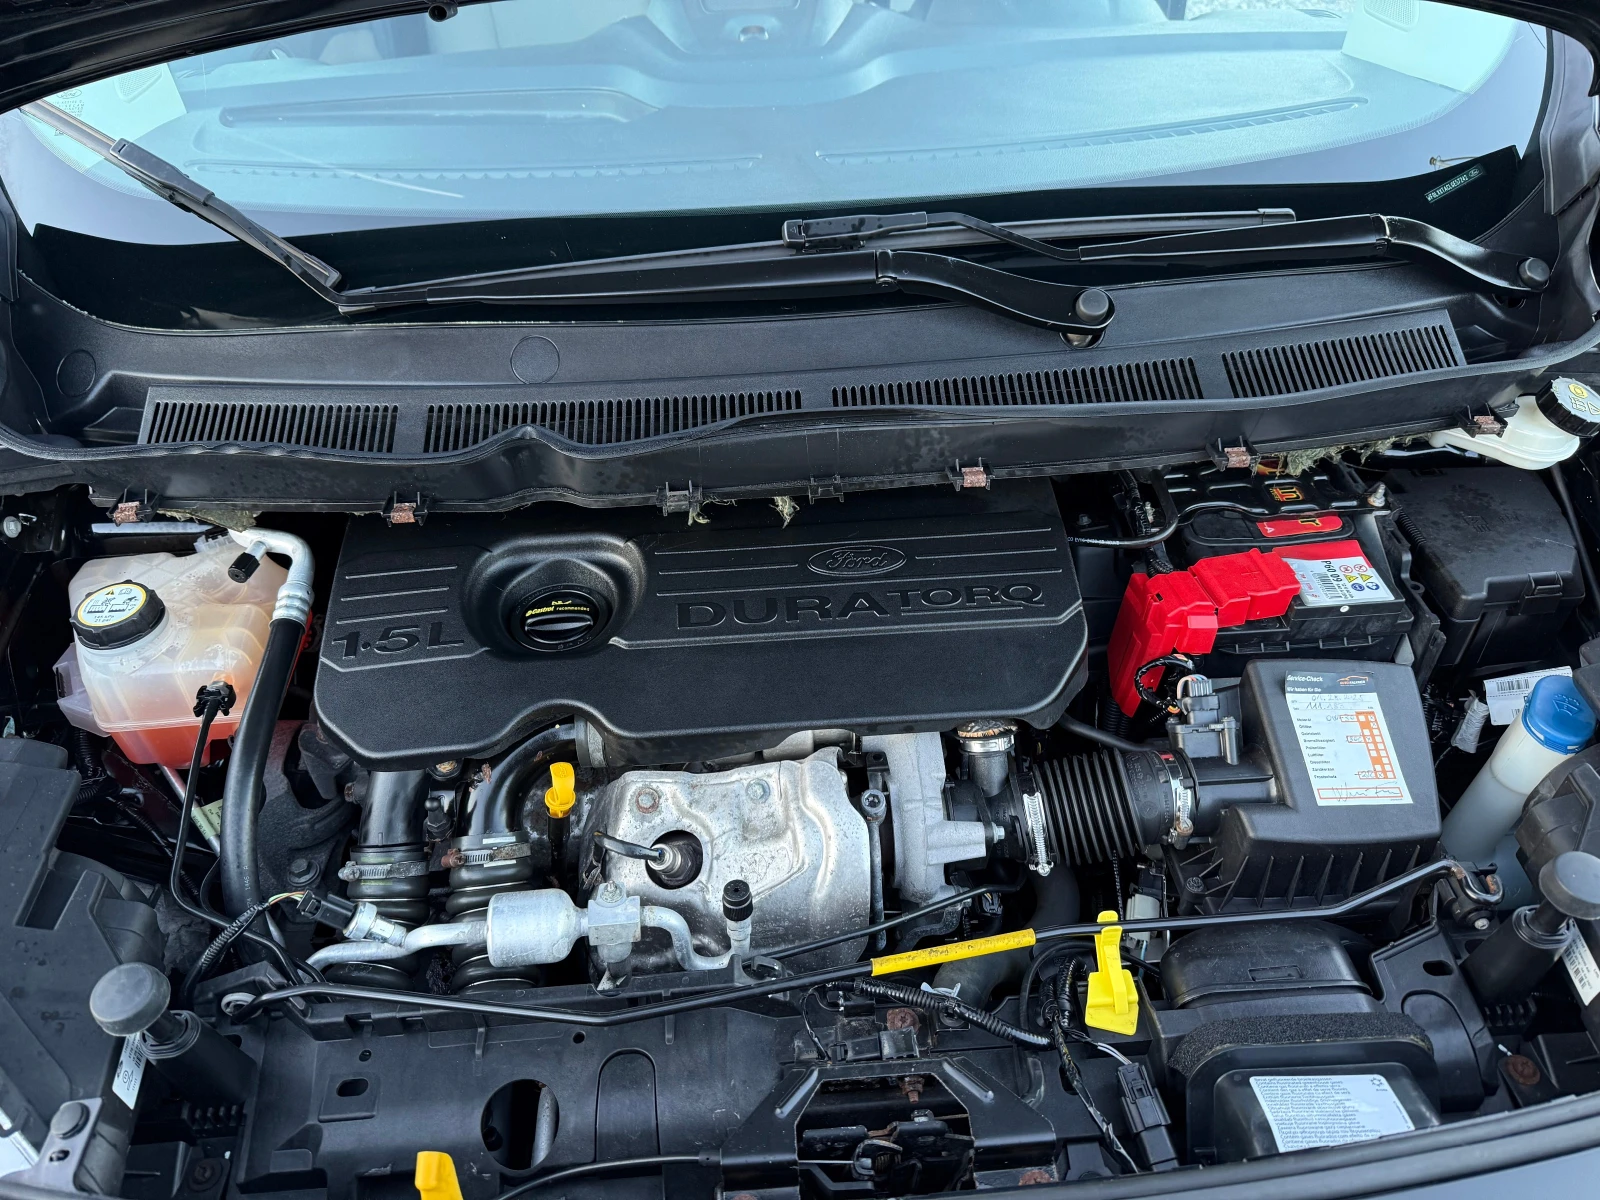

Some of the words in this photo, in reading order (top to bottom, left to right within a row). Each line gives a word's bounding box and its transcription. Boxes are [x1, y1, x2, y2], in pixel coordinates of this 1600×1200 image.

[531, 605, 555, 615] Castrol
[677, 582, 1045, 630] DURATORQ
[331, 621, 465, 659] 1.5L
[1287, 674, 1323, 682] Service-Check
